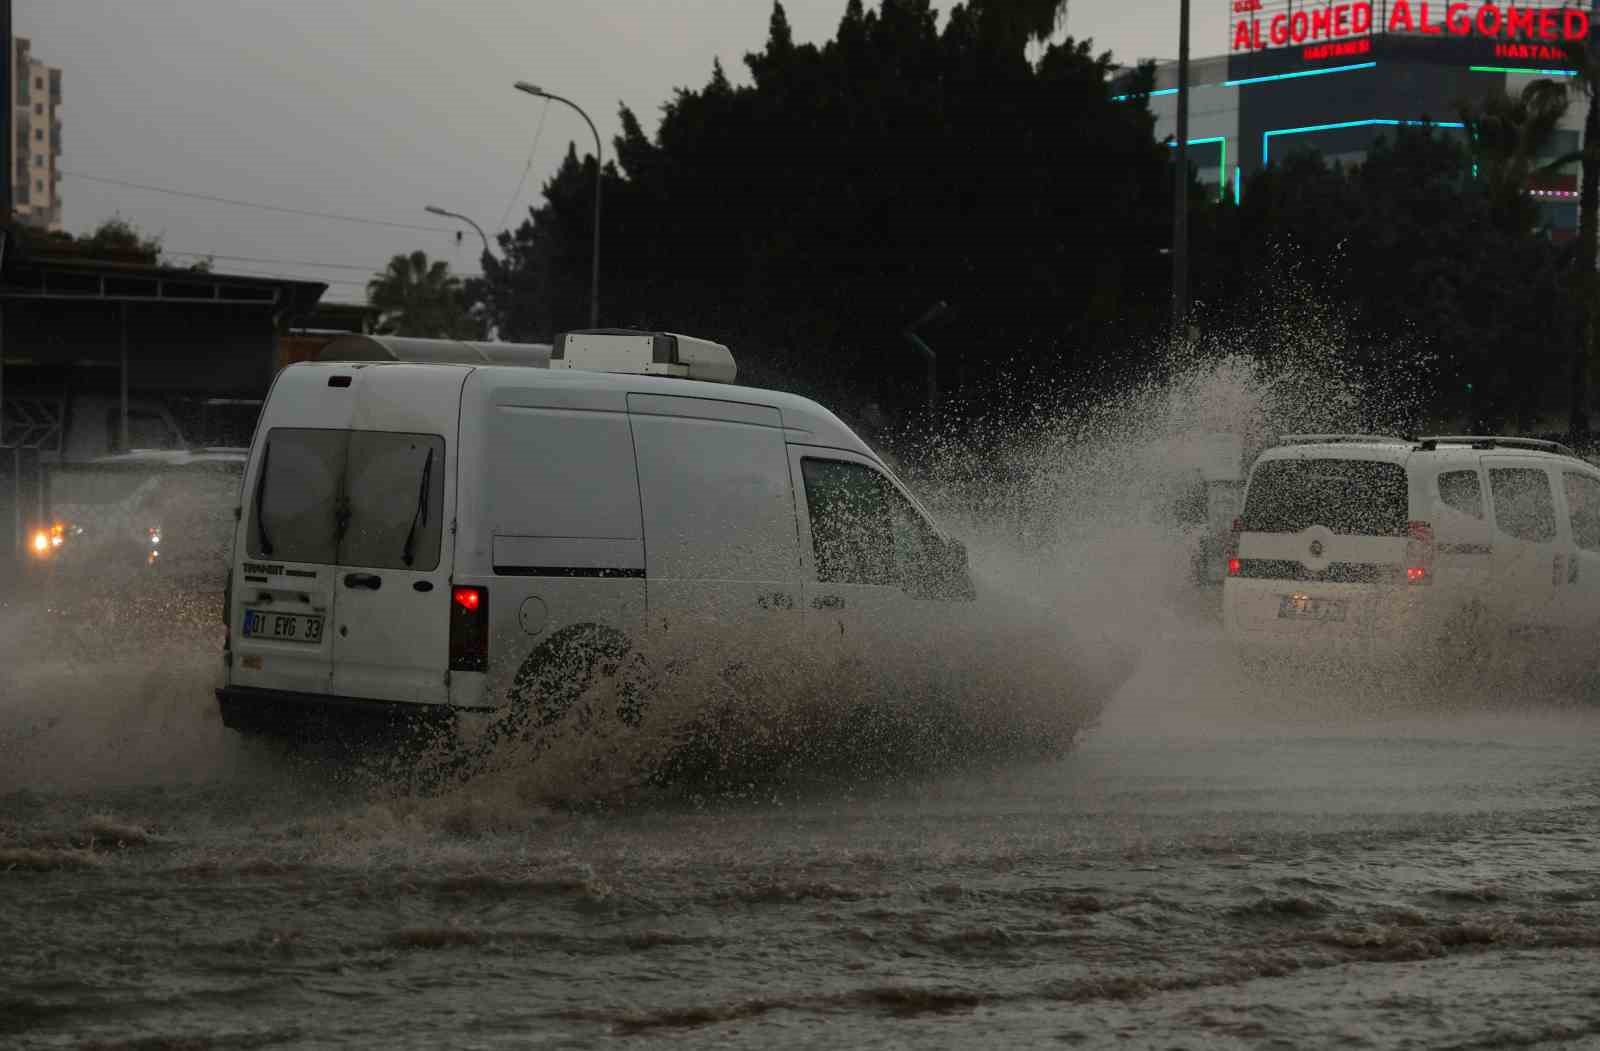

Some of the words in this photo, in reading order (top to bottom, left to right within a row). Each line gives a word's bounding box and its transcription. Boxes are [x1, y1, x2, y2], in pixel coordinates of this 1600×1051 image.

[1232, 2, 1372, 49] ALGOMED
[1388, 0, 1589, 41] ALGOMED
[304, 619, 320, 638] 33
